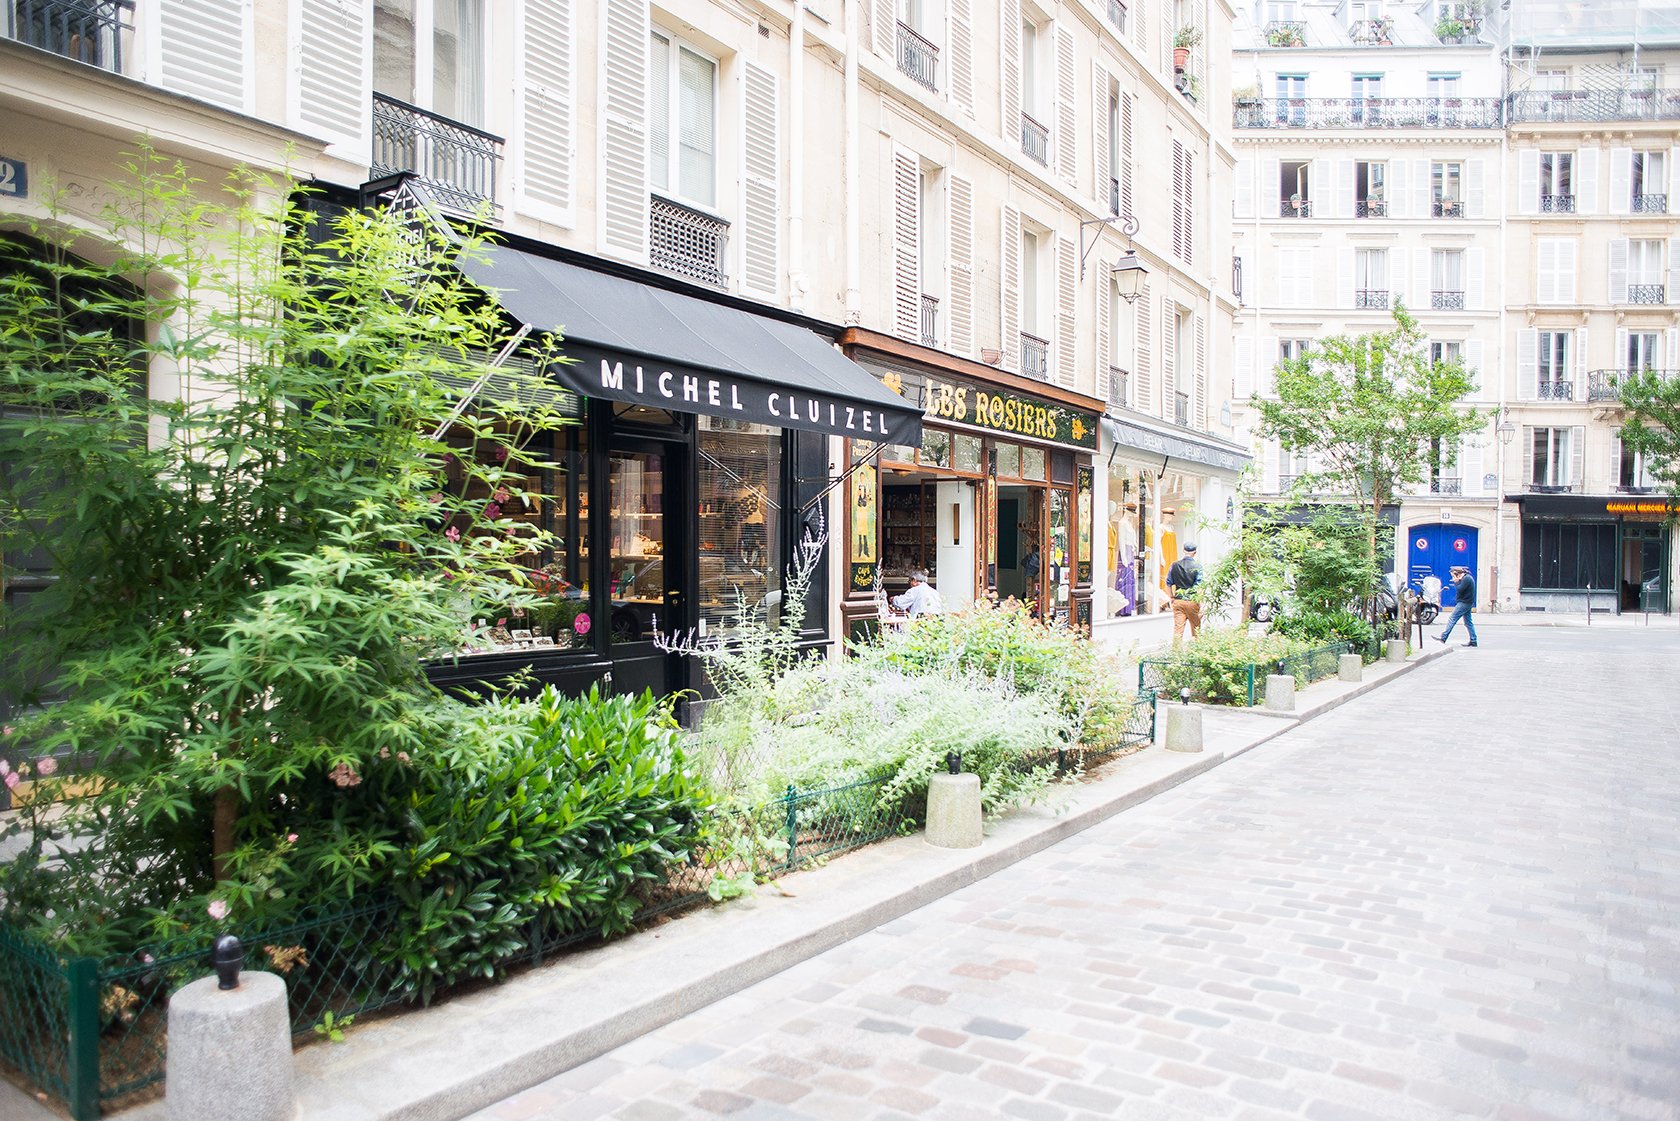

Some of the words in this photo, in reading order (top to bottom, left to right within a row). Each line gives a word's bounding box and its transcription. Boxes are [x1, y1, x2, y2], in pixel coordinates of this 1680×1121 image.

[601, 359, 743, 411] MICHEL
[767, 392, 889, 435] CLUIZEL
[925, 378, 967, 420] LES
[975, 391, 1057, 439] ROSIERS
